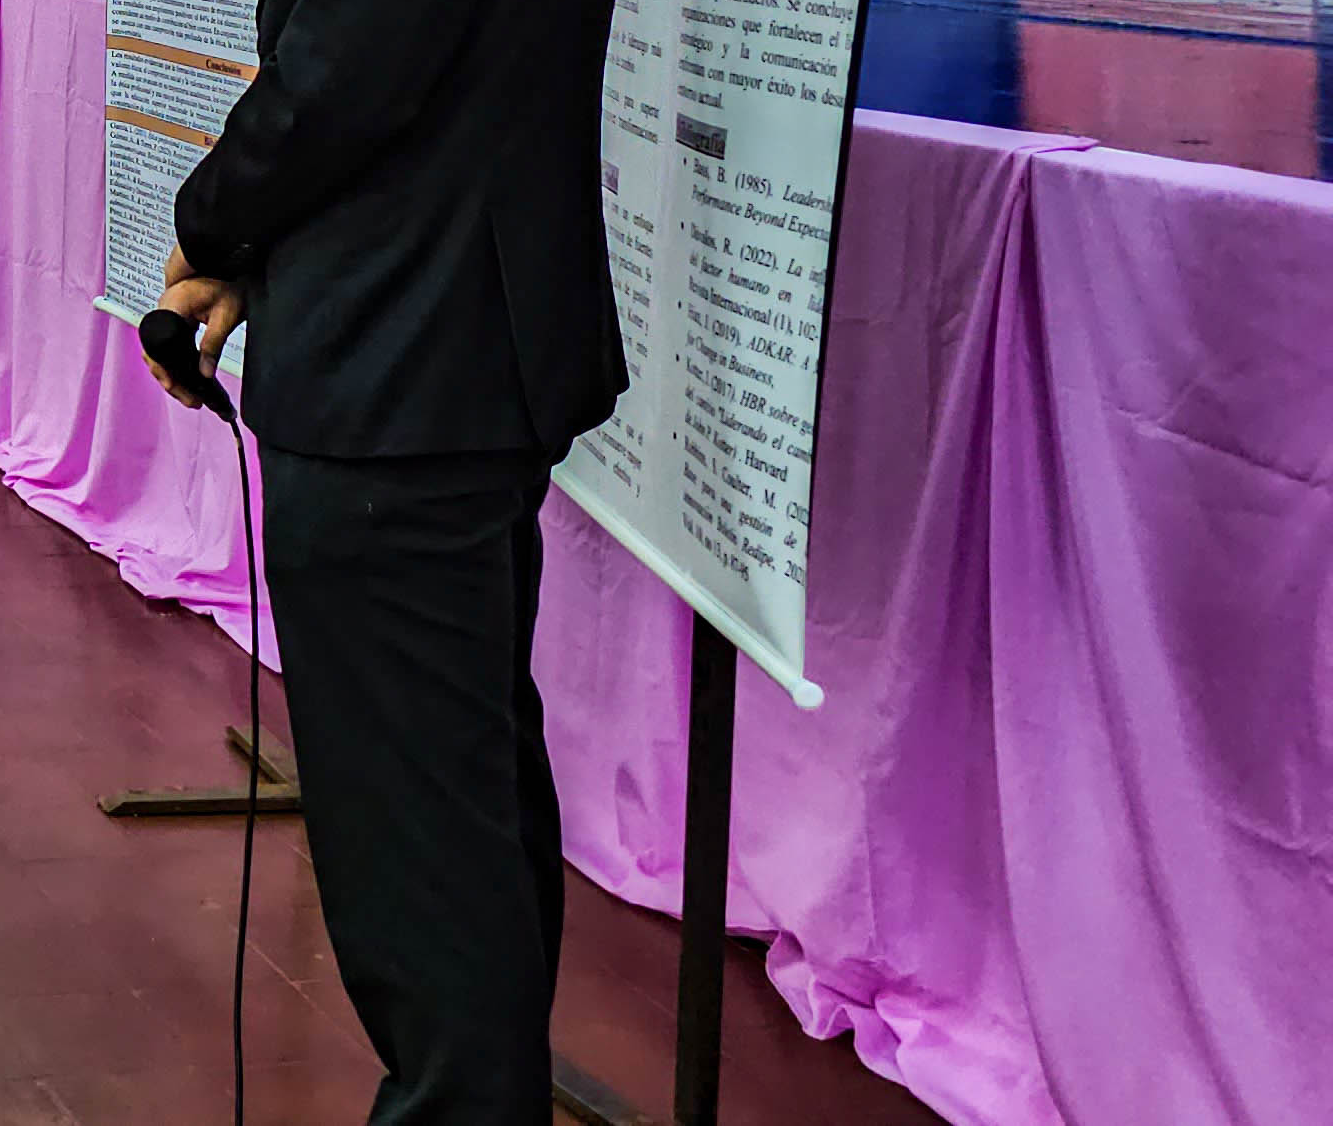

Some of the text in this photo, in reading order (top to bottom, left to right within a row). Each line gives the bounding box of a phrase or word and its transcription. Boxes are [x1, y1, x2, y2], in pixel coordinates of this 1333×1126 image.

[805, 0, 853, 24] concluye
[742, 19, 840, 49] que fortalecen el
[740, 42, 838, 77] la comunicación
[708, 67, 817, 101] con mayor éxito los
[717, 166, 773, 199] B. (1985).
[744, 203, 787, 227] Beyond
[786, 258, 802, 277] La
[728, 268, 792, 303] humano en
[729, 355, 774, 389] Business,
[740, 390, 799, 427] HBR sobre
[771, 435, 784, 451] el
[745, 449, 788, 482] Harvard
